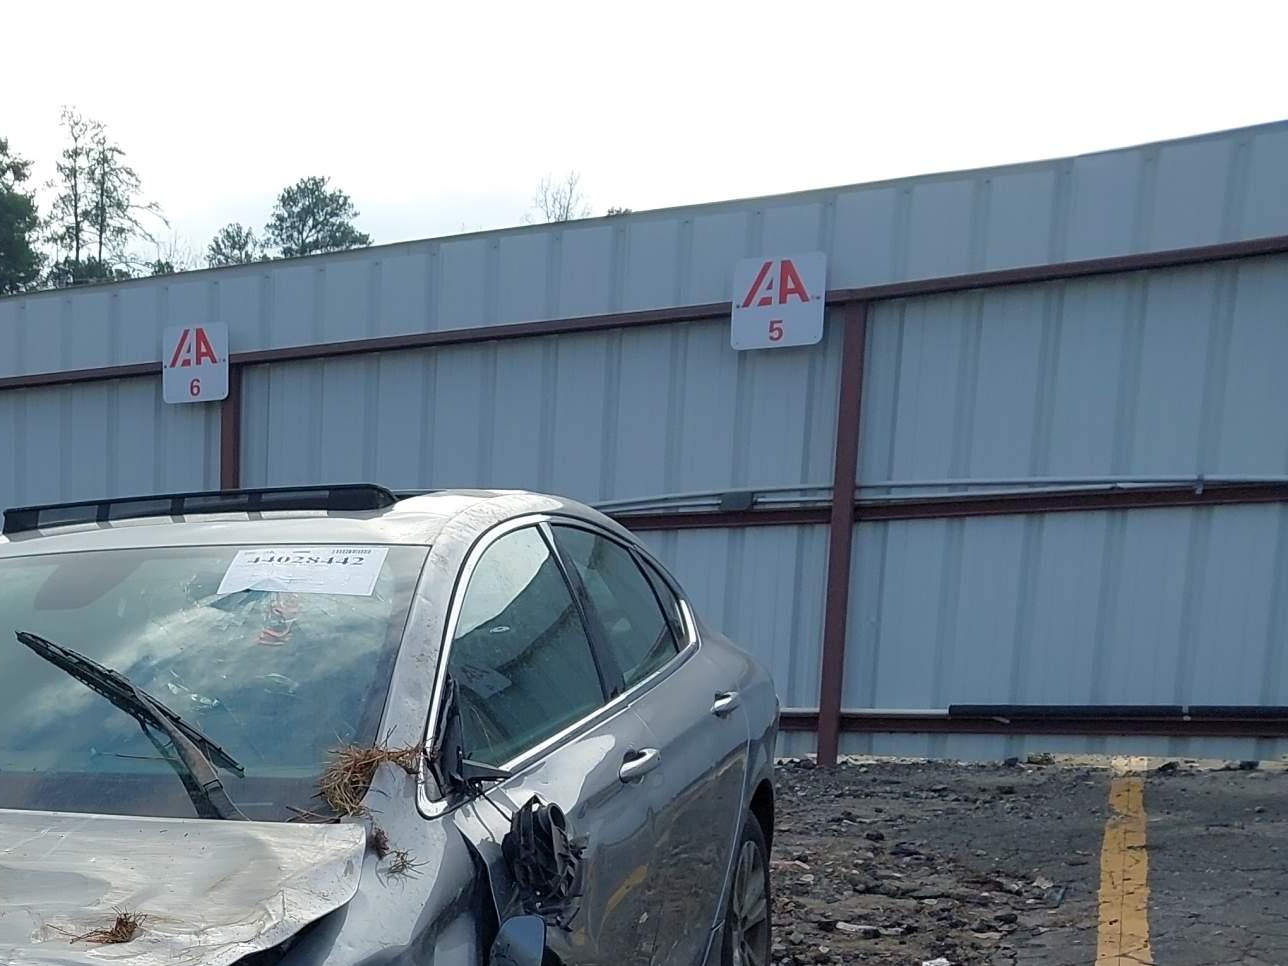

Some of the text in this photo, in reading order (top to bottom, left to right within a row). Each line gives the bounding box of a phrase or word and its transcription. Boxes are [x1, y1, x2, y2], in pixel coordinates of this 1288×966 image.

[768, 319, 784, 342] 5
[189, 378, 201, 397] 6
[247, 556, 365, 565] 44028442
